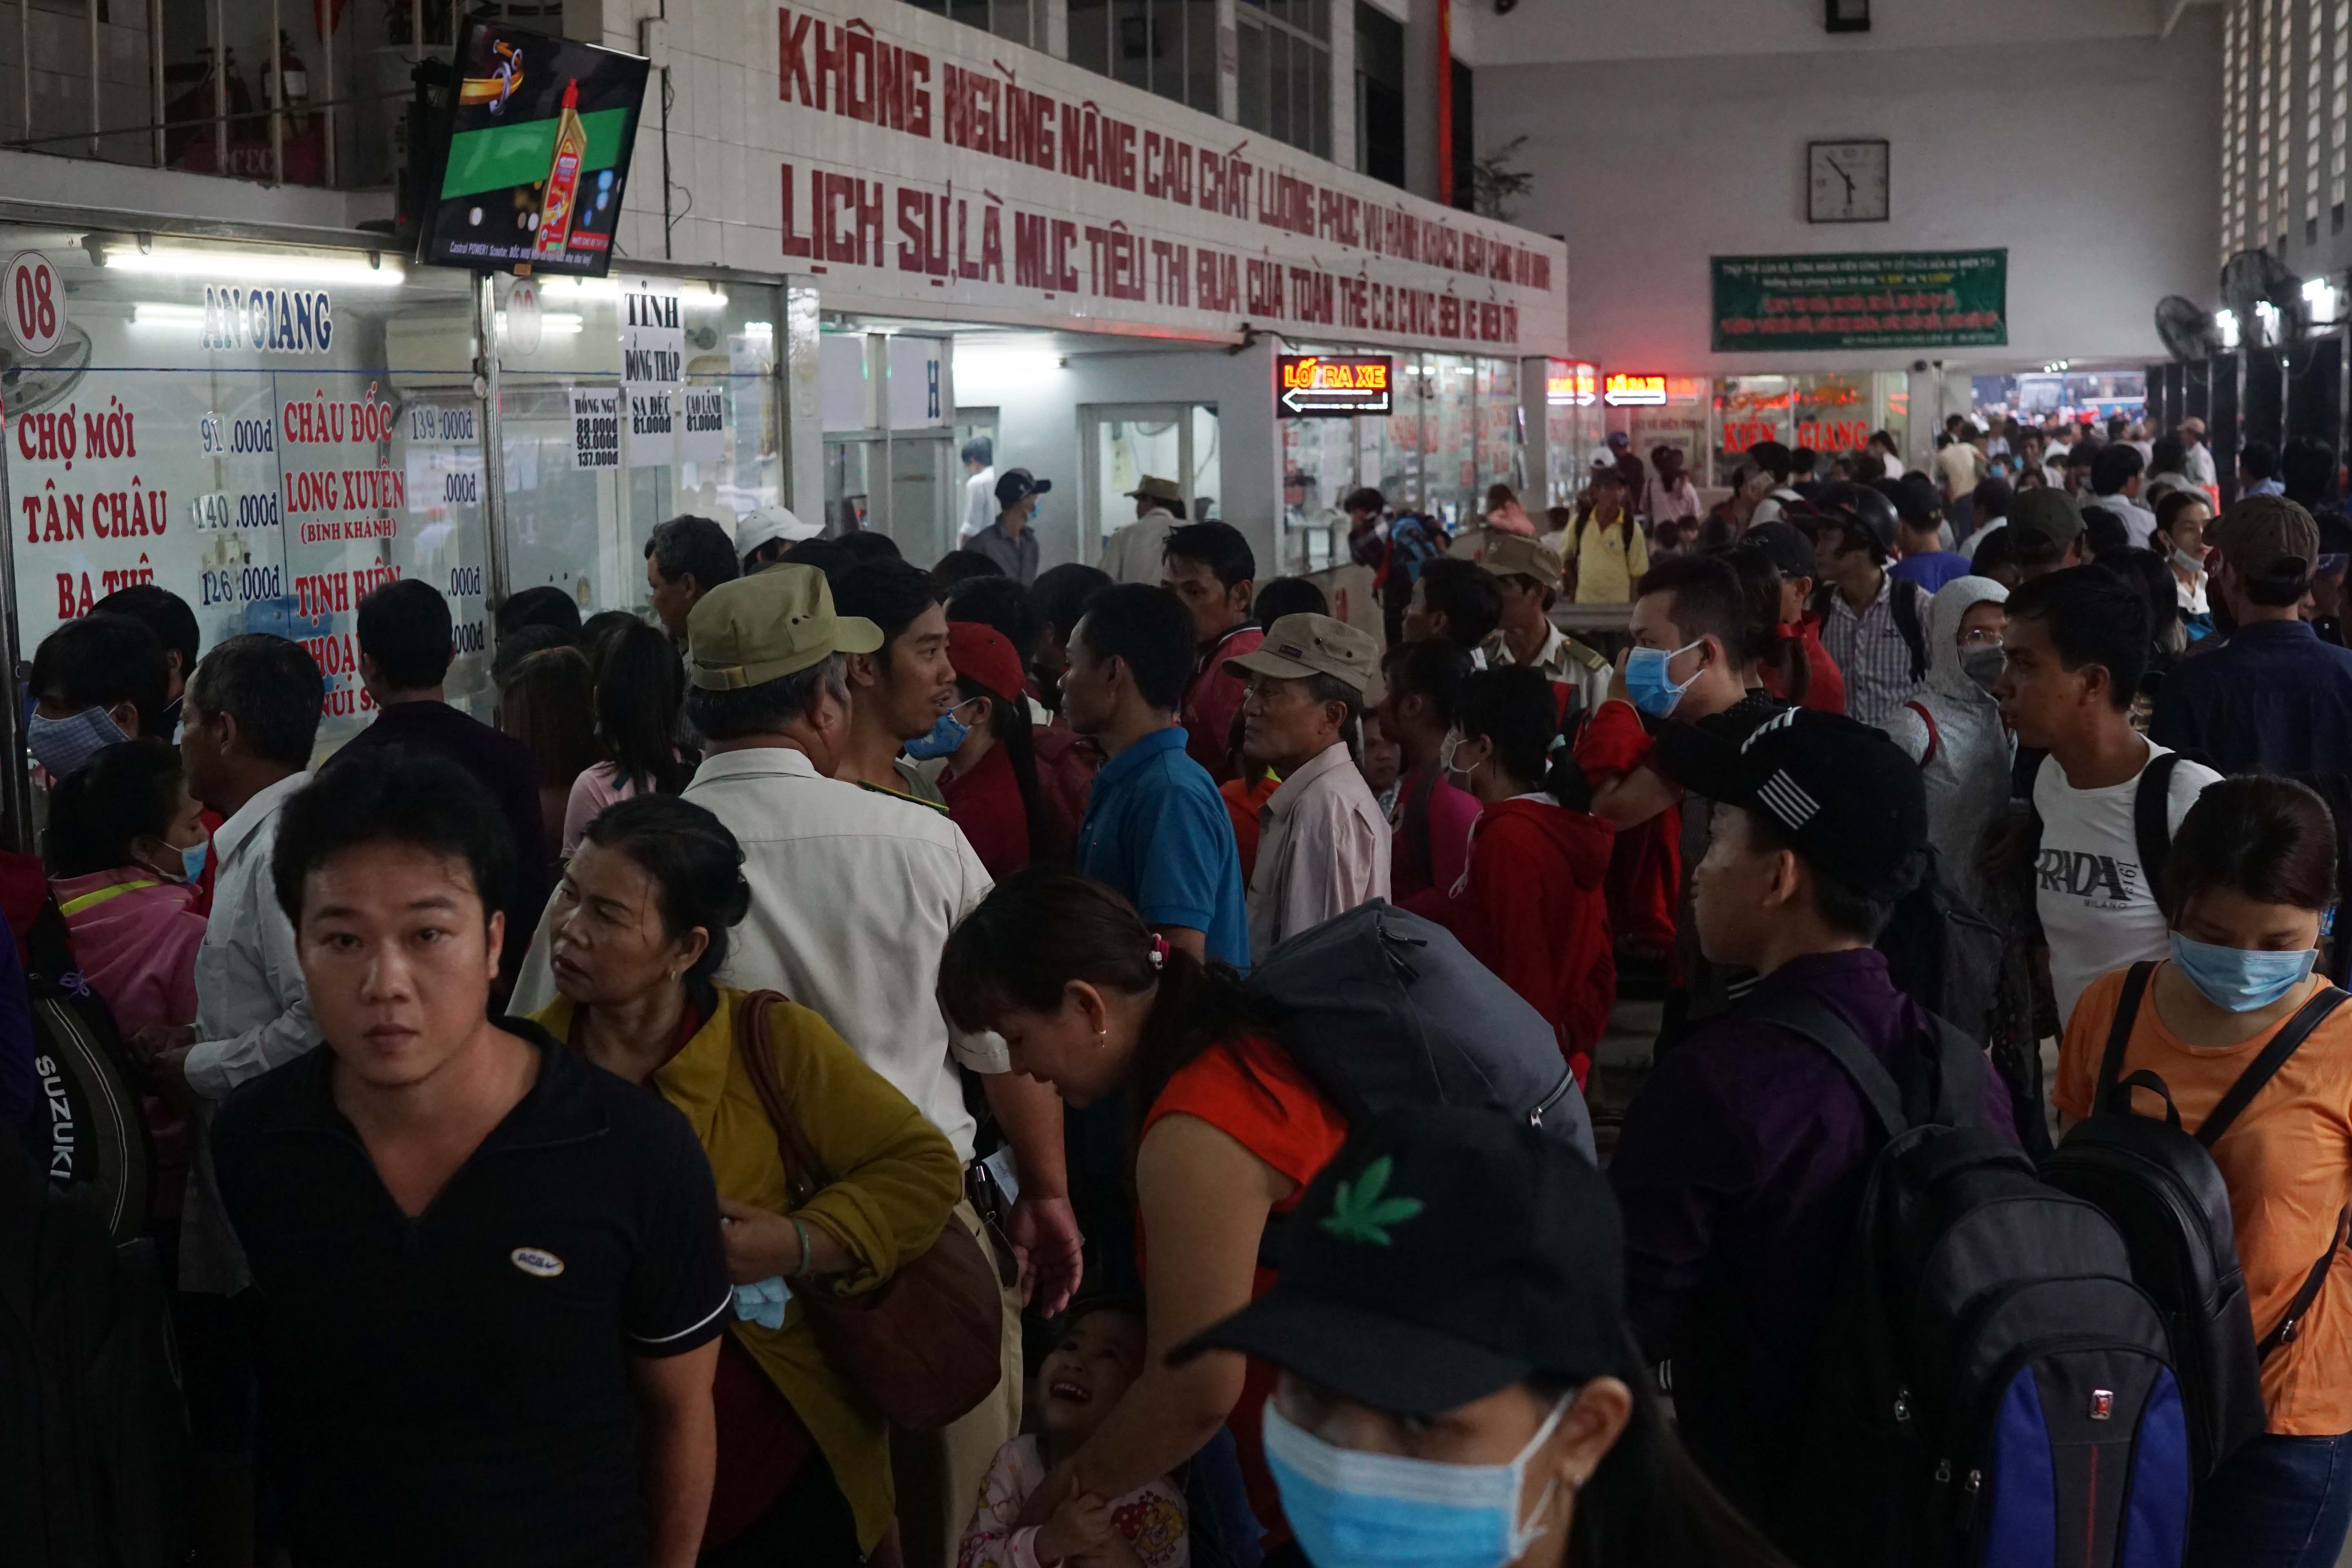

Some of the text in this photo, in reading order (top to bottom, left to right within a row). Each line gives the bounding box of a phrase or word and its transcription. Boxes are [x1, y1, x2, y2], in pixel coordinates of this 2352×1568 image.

[779, 7, 932, 138] KHÔNG
[944, 59, 1055, 171] NGỪNG
[1061, 100, 1136, 192] NÂNG
[1145, 130, 1192, 206] CAO
[1199, 139, 1253, 220] CHẤT
[782, 163, 883, 274] LỊCH
[959, 188, 1004, 285] LÀ
[1015, 210, 1078, 300] MỤC
[1085, 220, 1145, 302] TIÊU
[16, 264, 56, 340] 08
[203, 286, 332, 351] AN GIANG
[625, 280, 680, 328] TỈNH
[654, 341, 680, 382] THÁP
[1284, 358, 1386, 388] LỐI RA XE
[18, 395, 136, 471] CHỢ MỚI
[284, 381, 392, 443] CHÂU ĐỐC
[633, 396, 646, 416] SA
[1723, 412, 1868, 453] KIÊN GIANG
[23, 475, 167, 543] TÂN CHÂU
[286, 456, 404, 513] LONG XUYÊN
[301, 516, 396, 545] (BÌNH KHÁNH)
[57, 572, 94, 619] BA
[296, 572, 349, 626] TỊNH
[35, 1055, 74, 1180] SUZUKI
